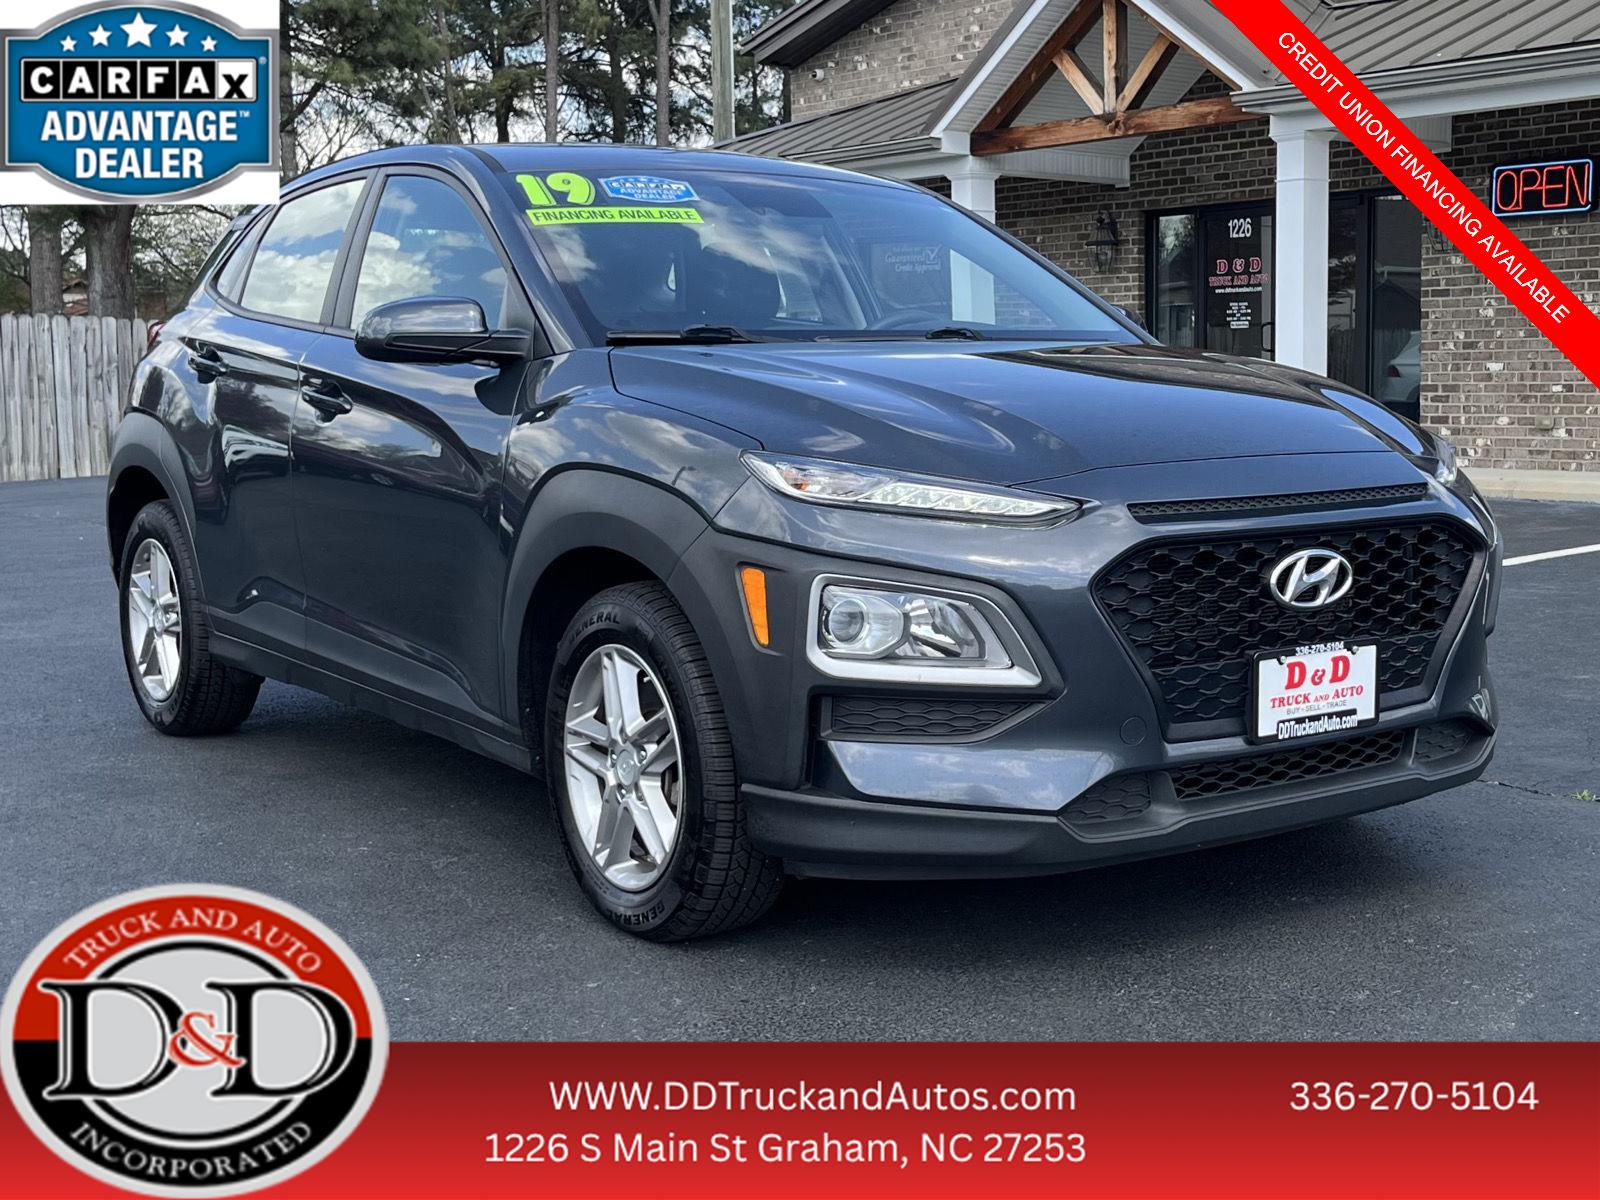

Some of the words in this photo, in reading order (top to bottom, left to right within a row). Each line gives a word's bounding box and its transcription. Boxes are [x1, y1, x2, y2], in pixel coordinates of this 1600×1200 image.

[515, 172, 596, 206] 19
[1497, 163, 1589, 211] OPEN
[534, 210, 614, 221] FINANCING
[618, 209, 697, 220] AVAILABLE
[1228, 218, 1252, 238] 1226
[1216, 259, 1229, 274] D
[1249, 257, 1262, 272] D
[1295, 641, 1344, 656] 336-270-5104
[1285, 661, 1307, 690] D
[1311, 668, 1326, 686] &
[1329, 655, 1350, 683] D
[1270, 693, 1311, 708] TRUCK
[1314, 694, 1330, 703] AND
[1332, 685, 1364, 699] AUTO
[1278, 715, 1358, 739] DDTruckandAuto.com
[606, 901, 666, 926] GENERAL
